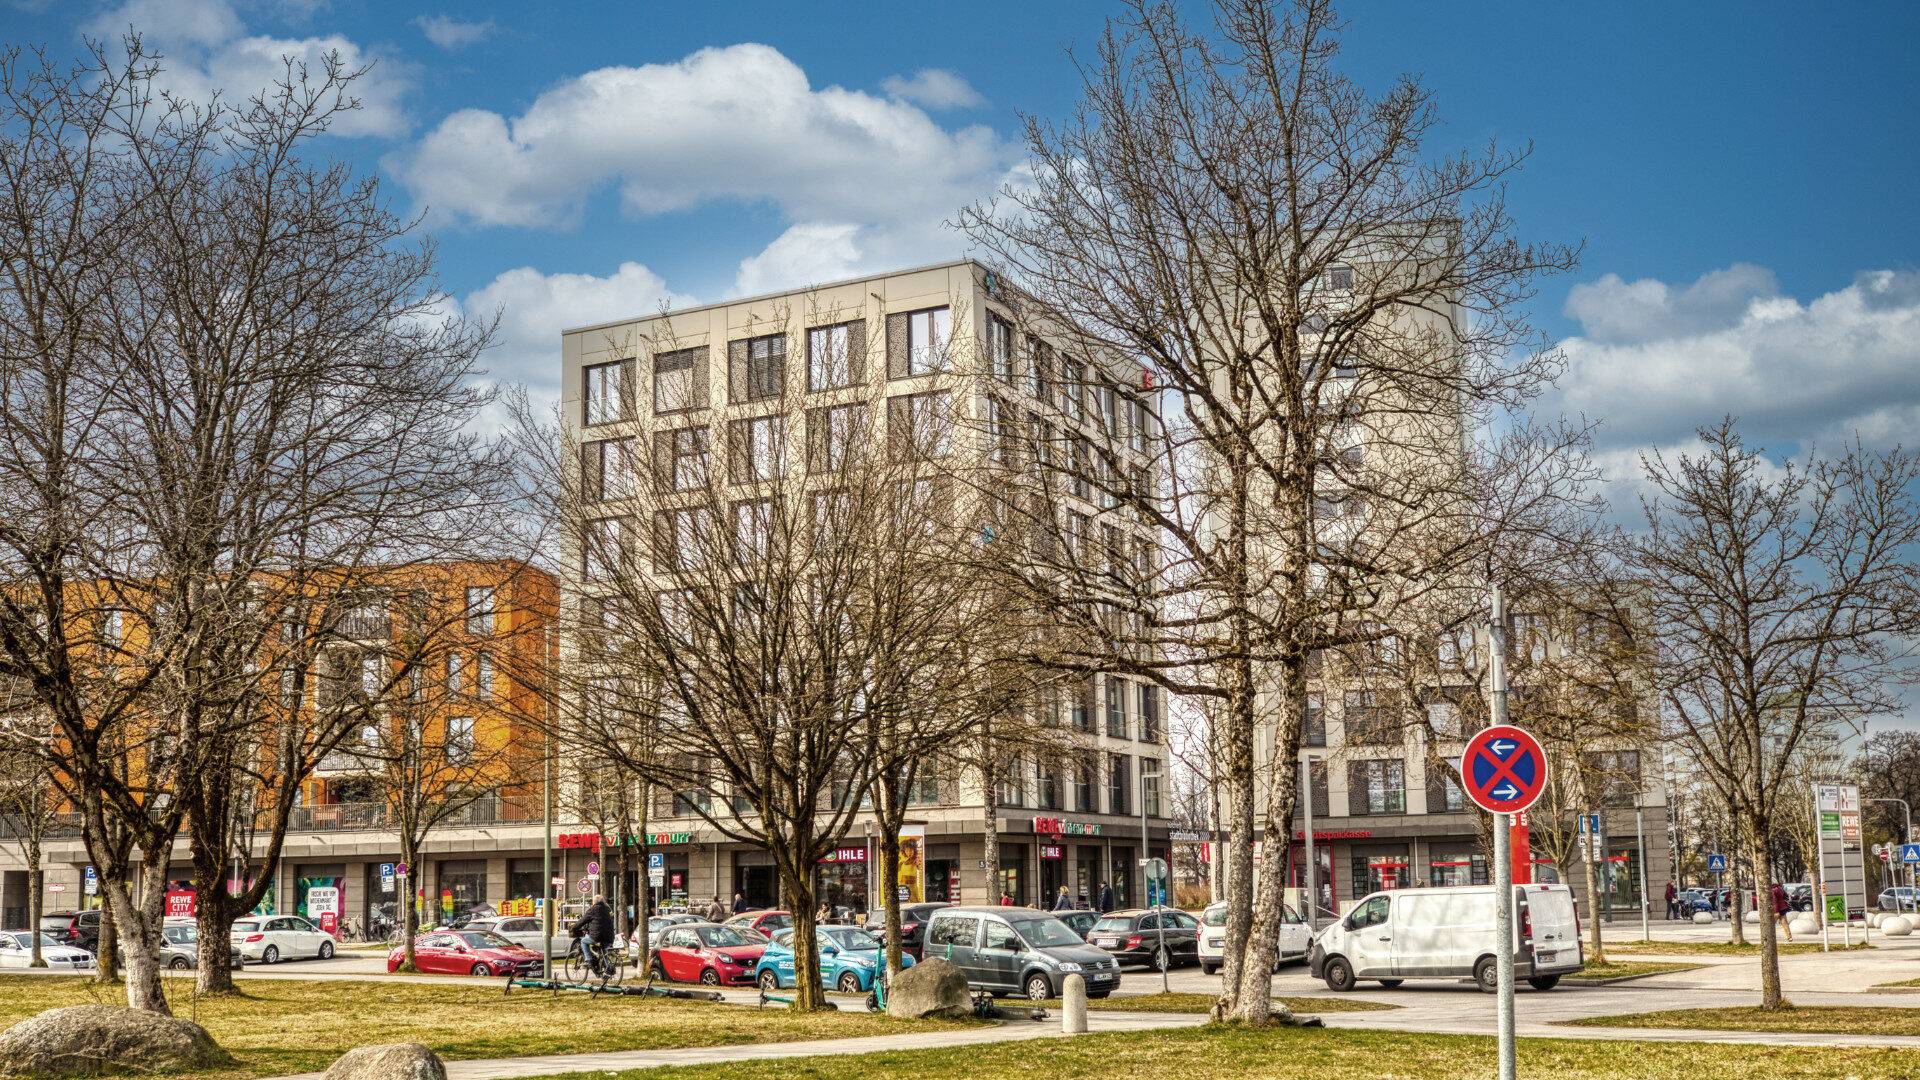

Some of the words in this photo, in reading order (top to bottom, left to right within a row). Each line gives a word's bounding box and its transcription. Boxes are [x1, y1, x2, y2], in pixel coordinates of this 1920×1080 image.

[606, 832, 689, 846] vinzmurr
[1296, 831, 1372, 841] Sdtsparkasse
[838, 849, 864, 860] IHLE
[1046, 847, 1059, 857] IHLE
[170, 896, 192, 904] REWE
